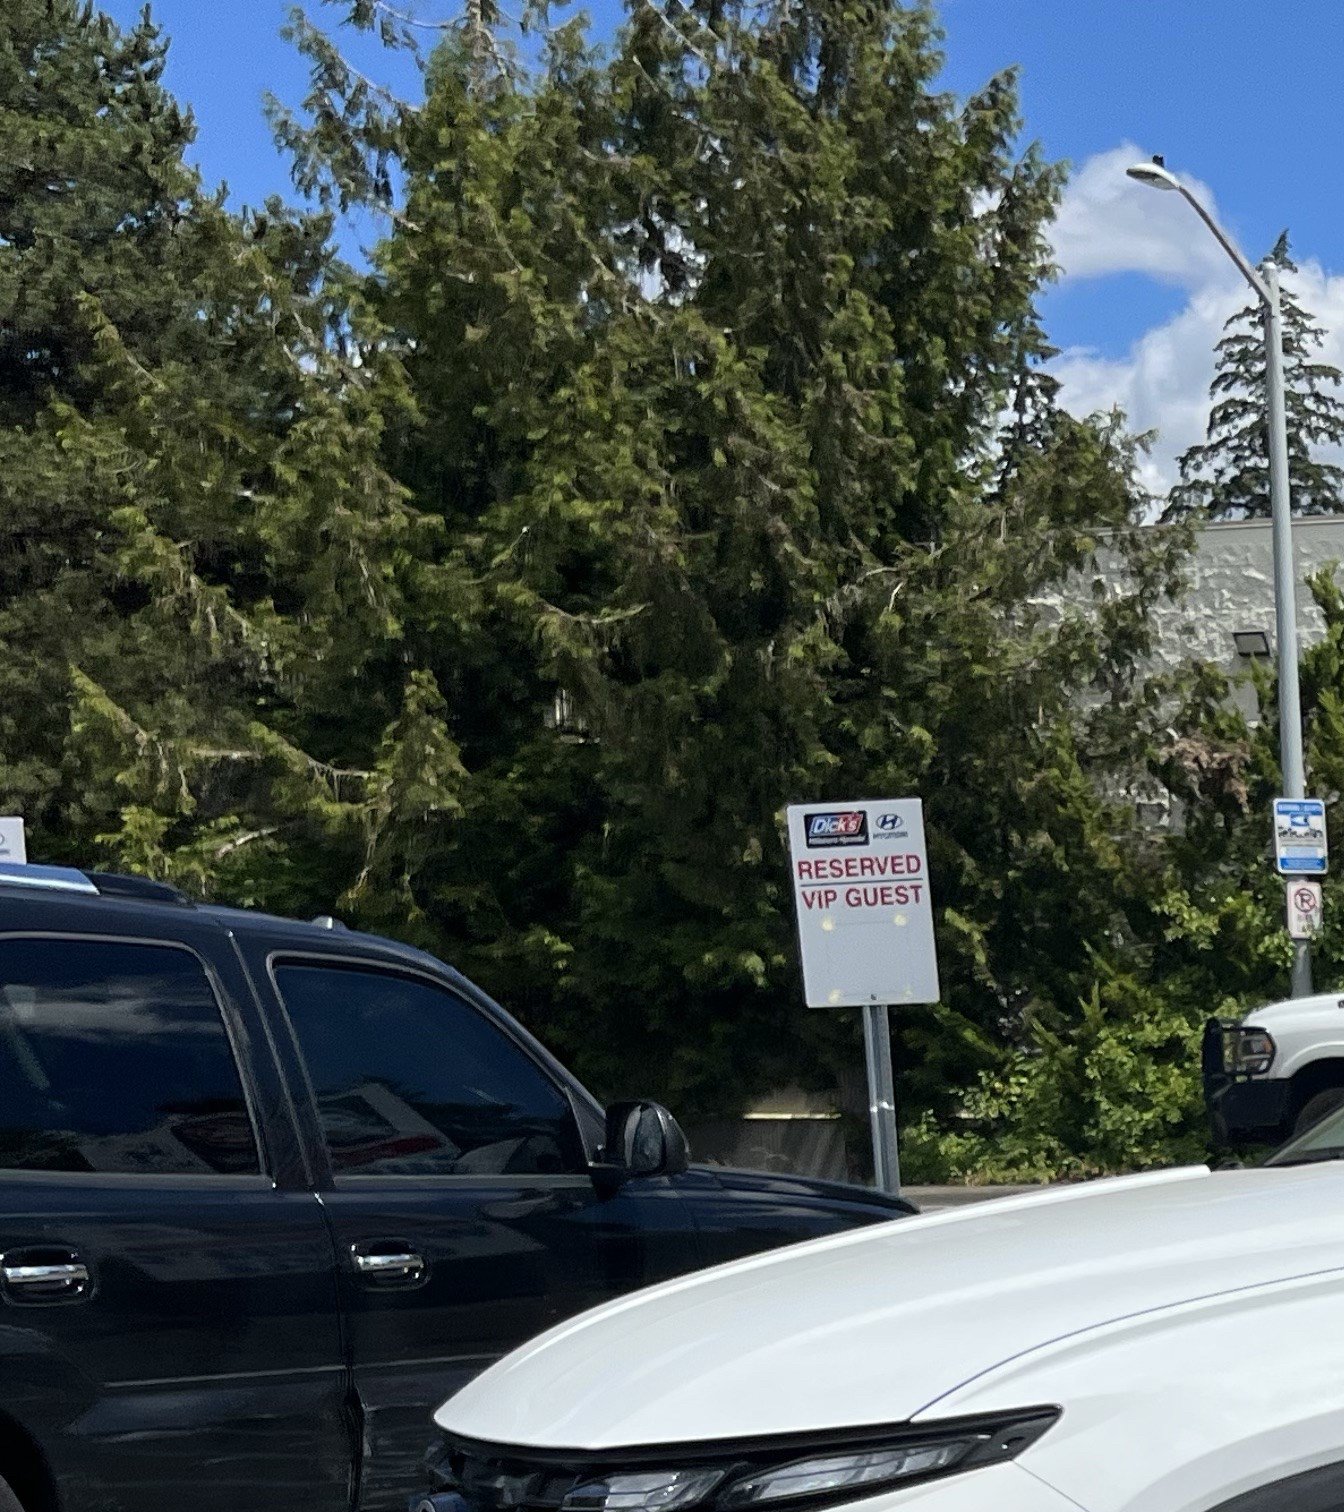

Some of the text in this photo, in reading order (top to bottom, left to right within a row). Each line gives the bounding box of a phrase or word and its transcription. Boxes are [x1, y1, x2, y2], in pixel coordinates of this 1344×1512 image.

[797, 854, 922, 880] RESERVED
[801, 885, 923, 910] VIP GUEST
